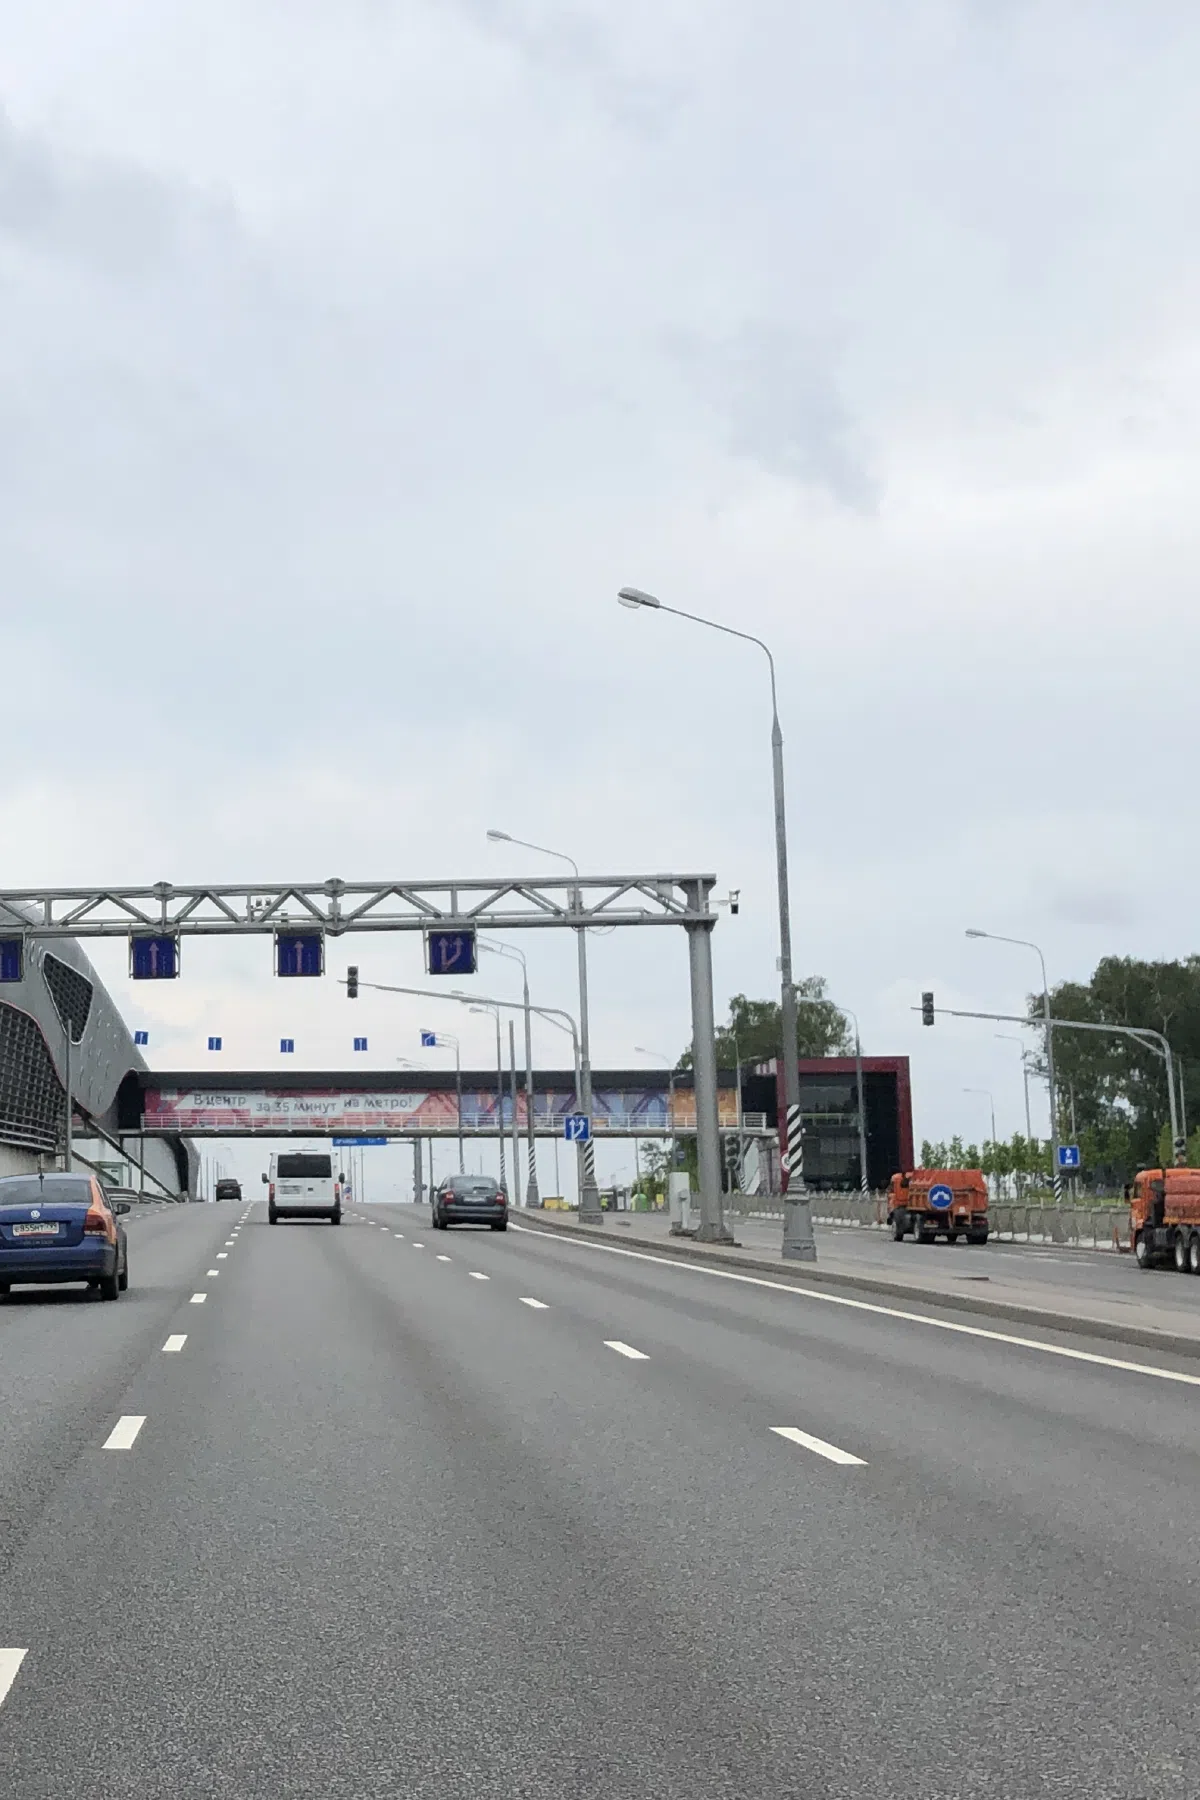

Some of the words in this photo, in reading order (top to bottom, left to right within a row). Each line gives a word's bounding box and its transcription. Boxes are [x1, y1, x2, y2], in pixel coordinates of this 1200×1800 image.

[194, 1094, 203, 1105] В
[206, 1095, 246, 1106] центр
[255, 1102, 271, 1112] за
[274, 1101, 290, 1113] 35
[293, 1102, 337, 1113] минут
[343, 1099, 360, 1108] на
[363, 1095, 413, 1110] метро!
